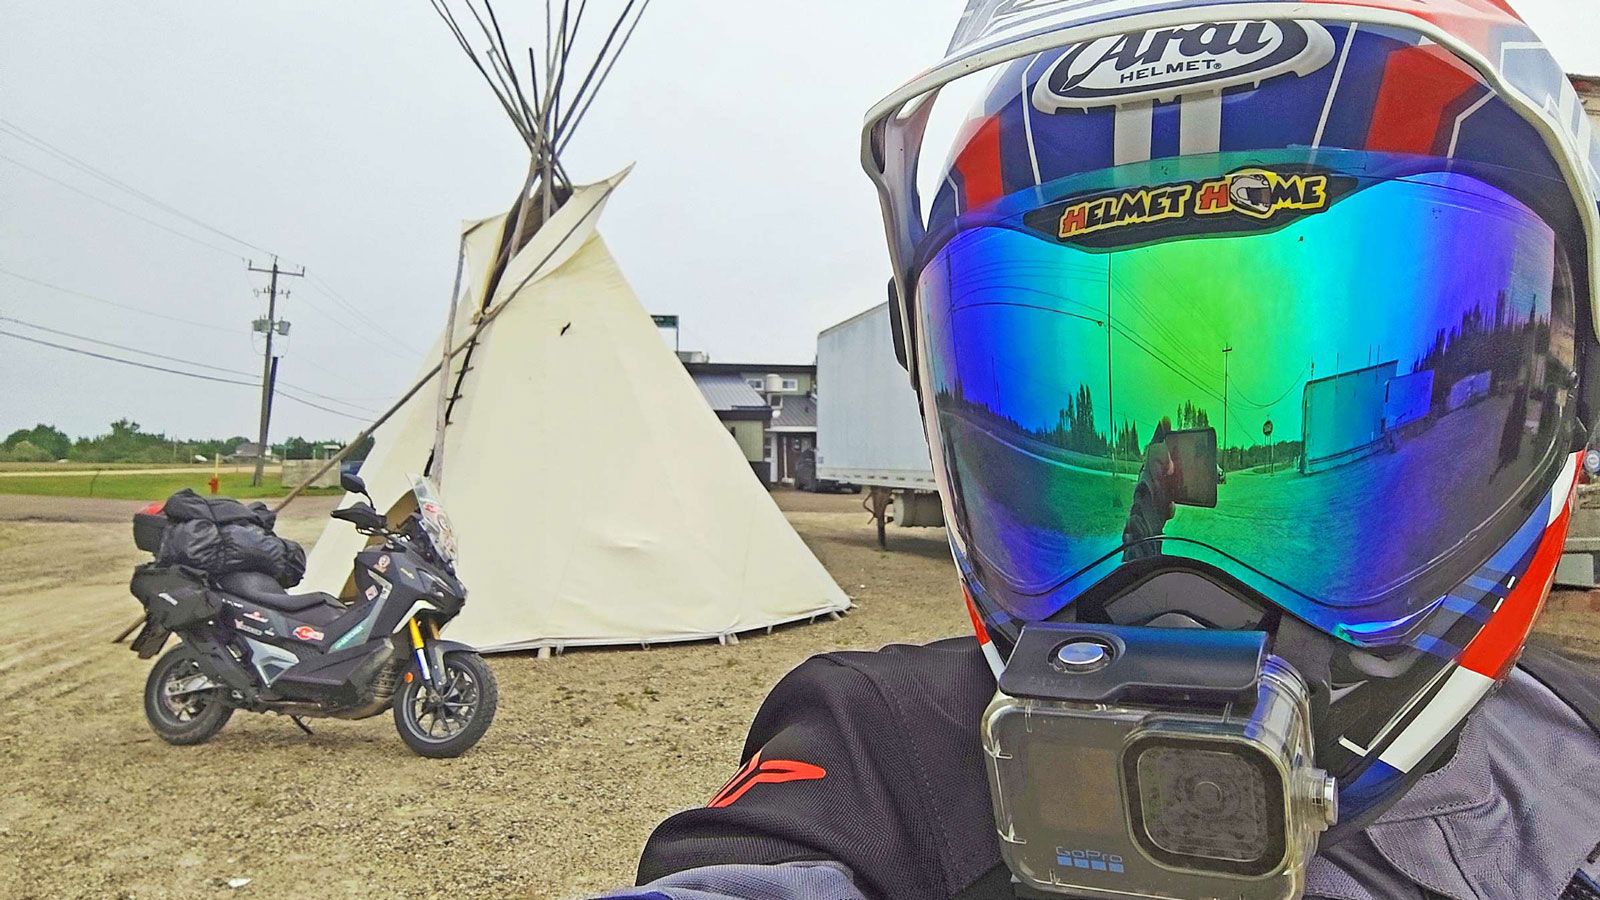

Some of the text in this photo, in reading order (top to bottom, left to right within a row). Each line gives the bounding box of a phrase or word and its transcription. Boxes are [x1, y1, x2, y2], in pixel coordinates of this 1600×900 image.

[1062, 19, 1276, 92] Arai
[1059, 186, 1191, 236] HELMET
[1055, 845, 1124, 863] GoPro
